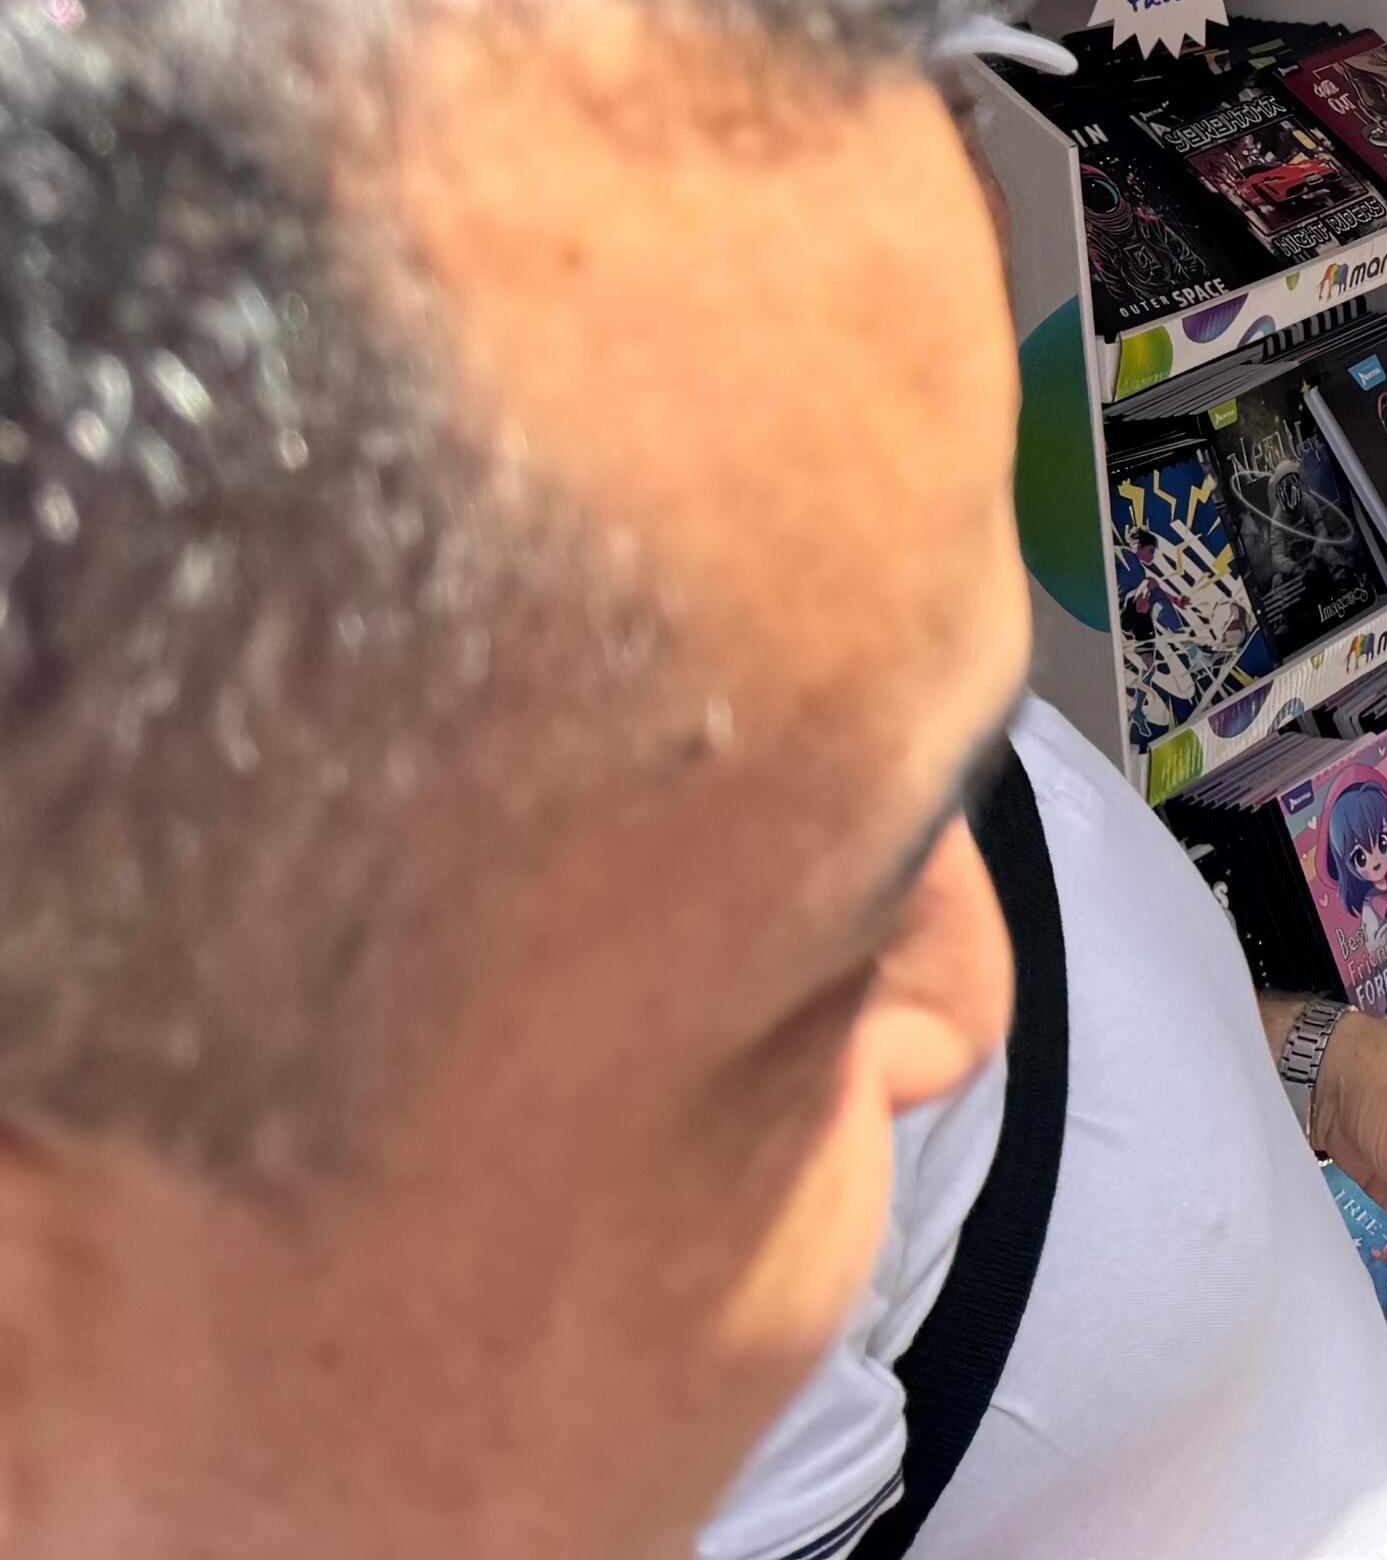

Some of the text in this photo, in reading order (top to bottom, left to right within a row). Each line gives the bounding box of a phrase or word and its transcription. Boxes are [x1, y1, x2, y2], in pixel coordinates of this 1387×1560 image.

[1071, 122, 1110, 148] IN
[1119, 277, 1230, 318] OUTER SPACE
